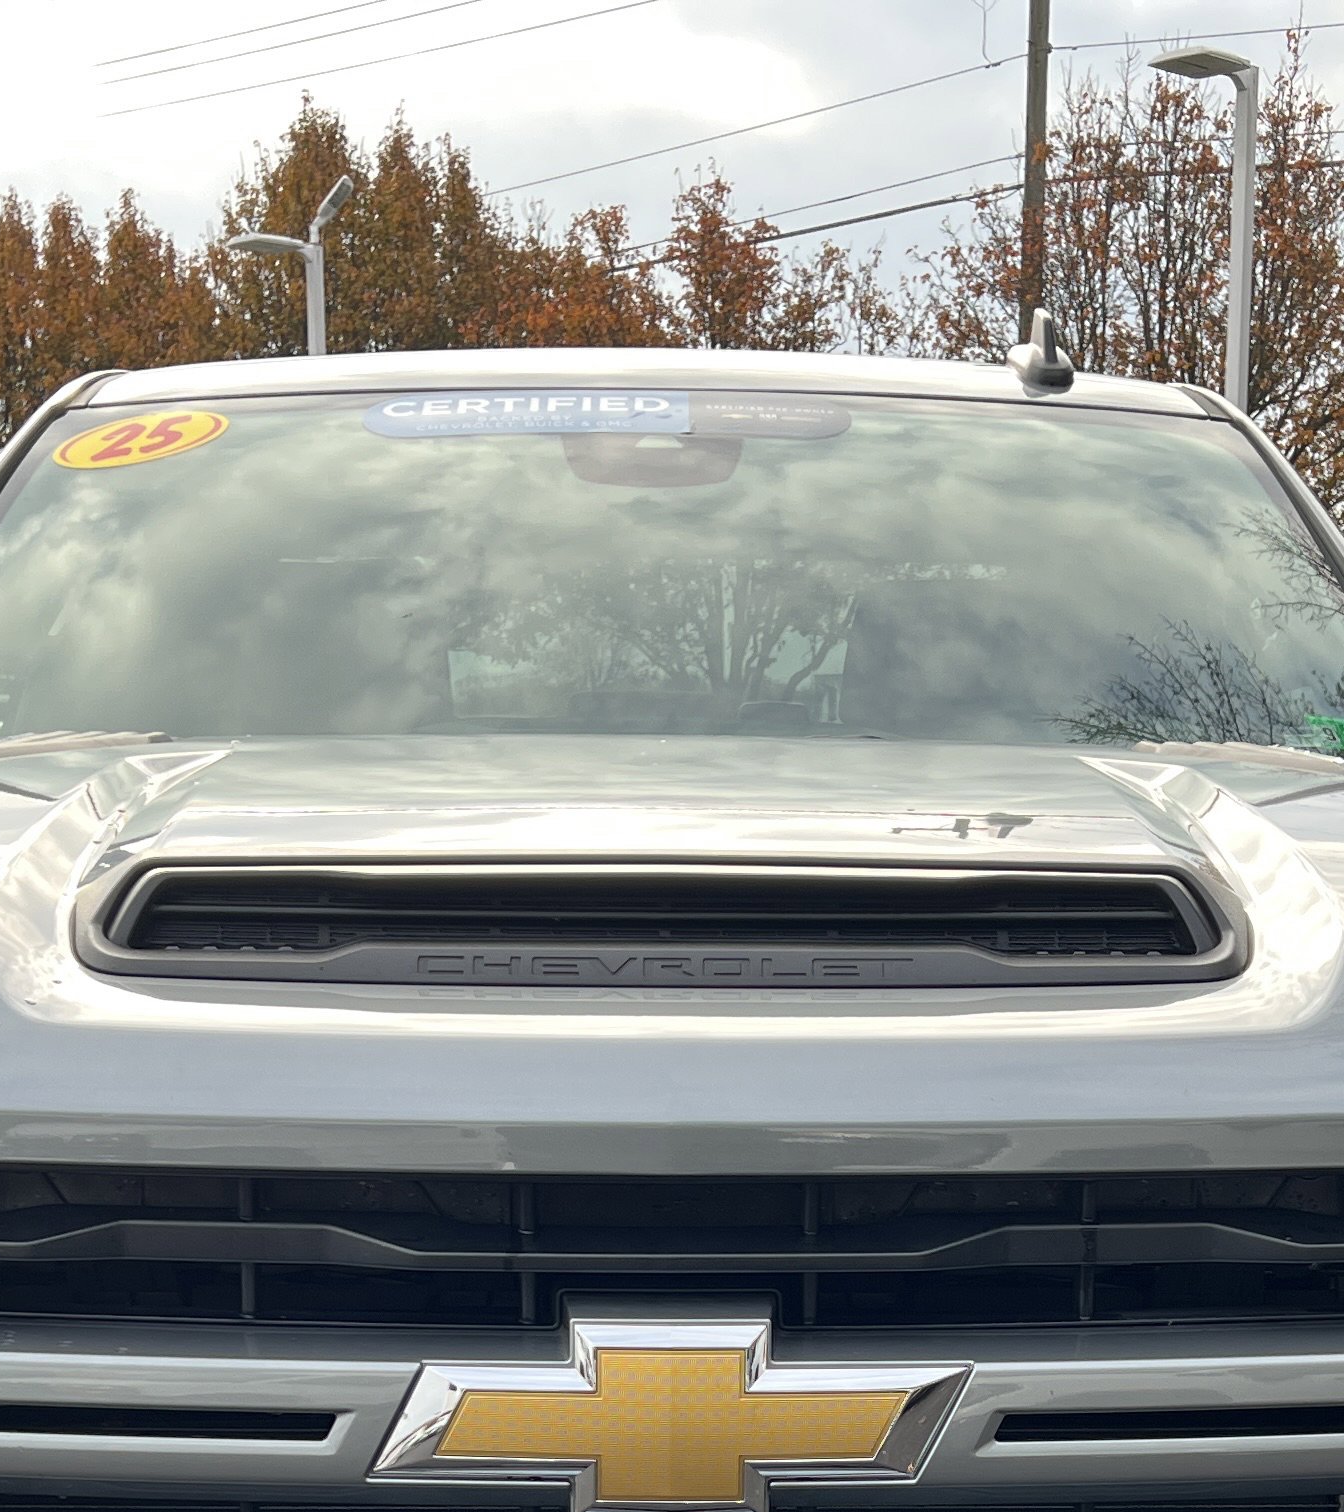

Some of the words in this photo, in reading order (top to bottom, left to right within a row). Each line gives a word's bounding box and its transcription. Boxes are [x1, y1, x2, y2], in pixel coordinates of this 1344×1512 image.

[382, 396, 670, 417] CERTIFIED
[416, 420, 514, 431] CHEVROLET
[90, 414, 193, 462] 25
[417, 955, 914, 977] CHEVROLET
